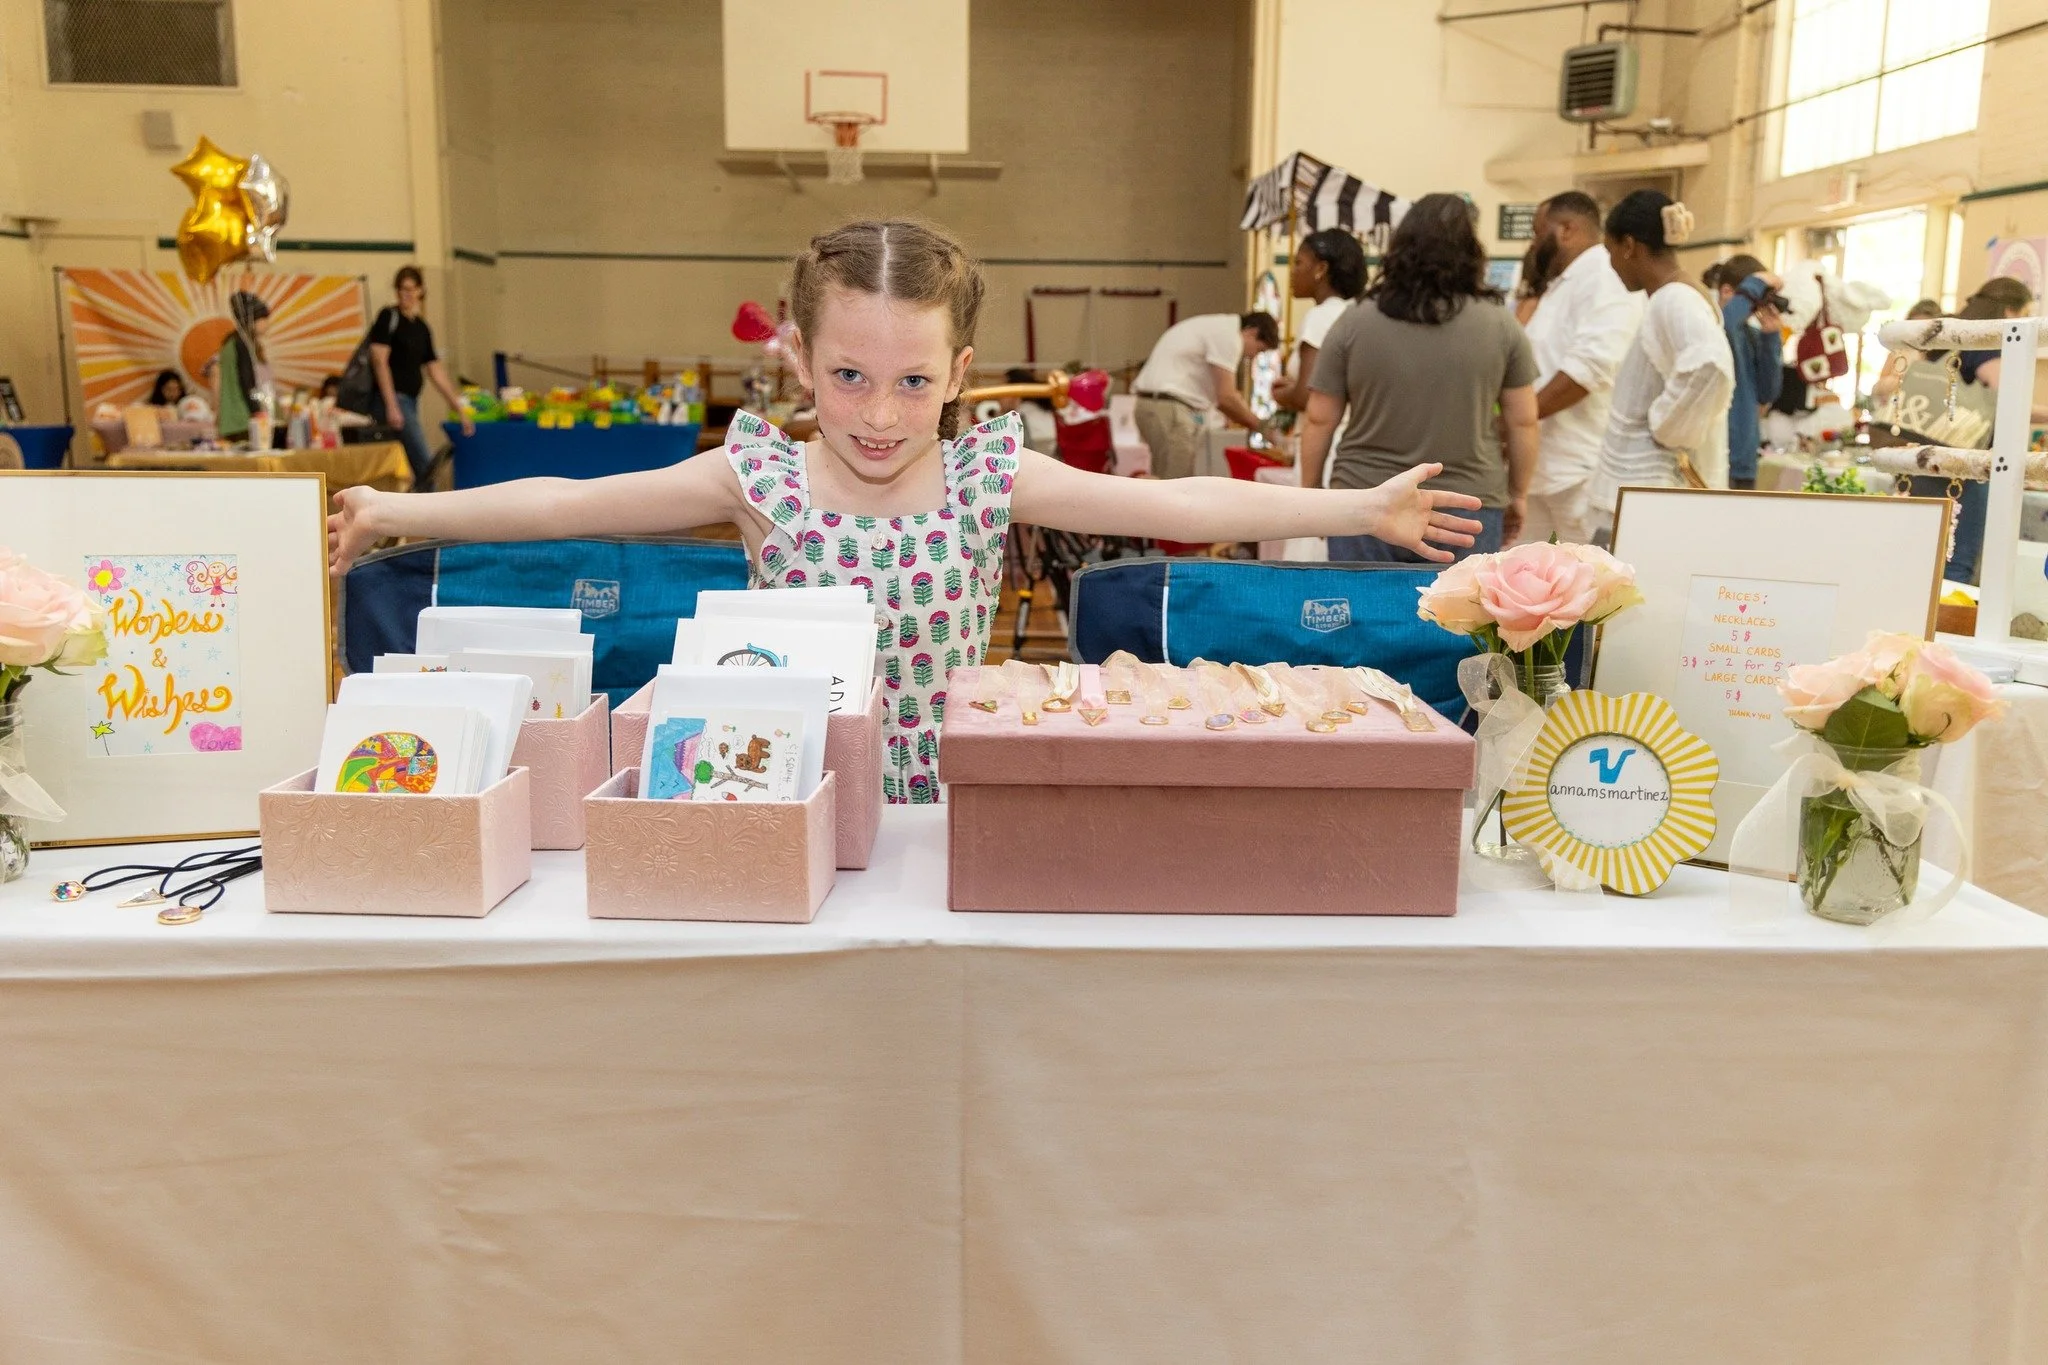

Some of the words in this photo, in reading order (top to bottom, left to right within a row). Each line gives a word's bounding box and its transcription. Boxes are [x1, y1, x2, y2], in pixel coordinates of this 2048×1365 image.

[1717, 585, 1768, 605] PRICES:
[575, 598, 616, 610] TIMBER
[1305, 614, 1346, 626] TIMBER
[1713, 614, 1776, 628] NECKLACES
[151, 647, 168, 668] &
[1708, 643, 1741, 654] SMALL
[1746, 646, 1782, 659] CARDS
[1725, 657, 1733, 667] 2
[1744, 659, 1764, 671] for
[1704, 671, 1738, 683] LARGE
[97, 664, 233, 735] Wishes
[1727, 708, 1750, 719] THANK
[1550, 784, 1669, 802] annamsmartinez
